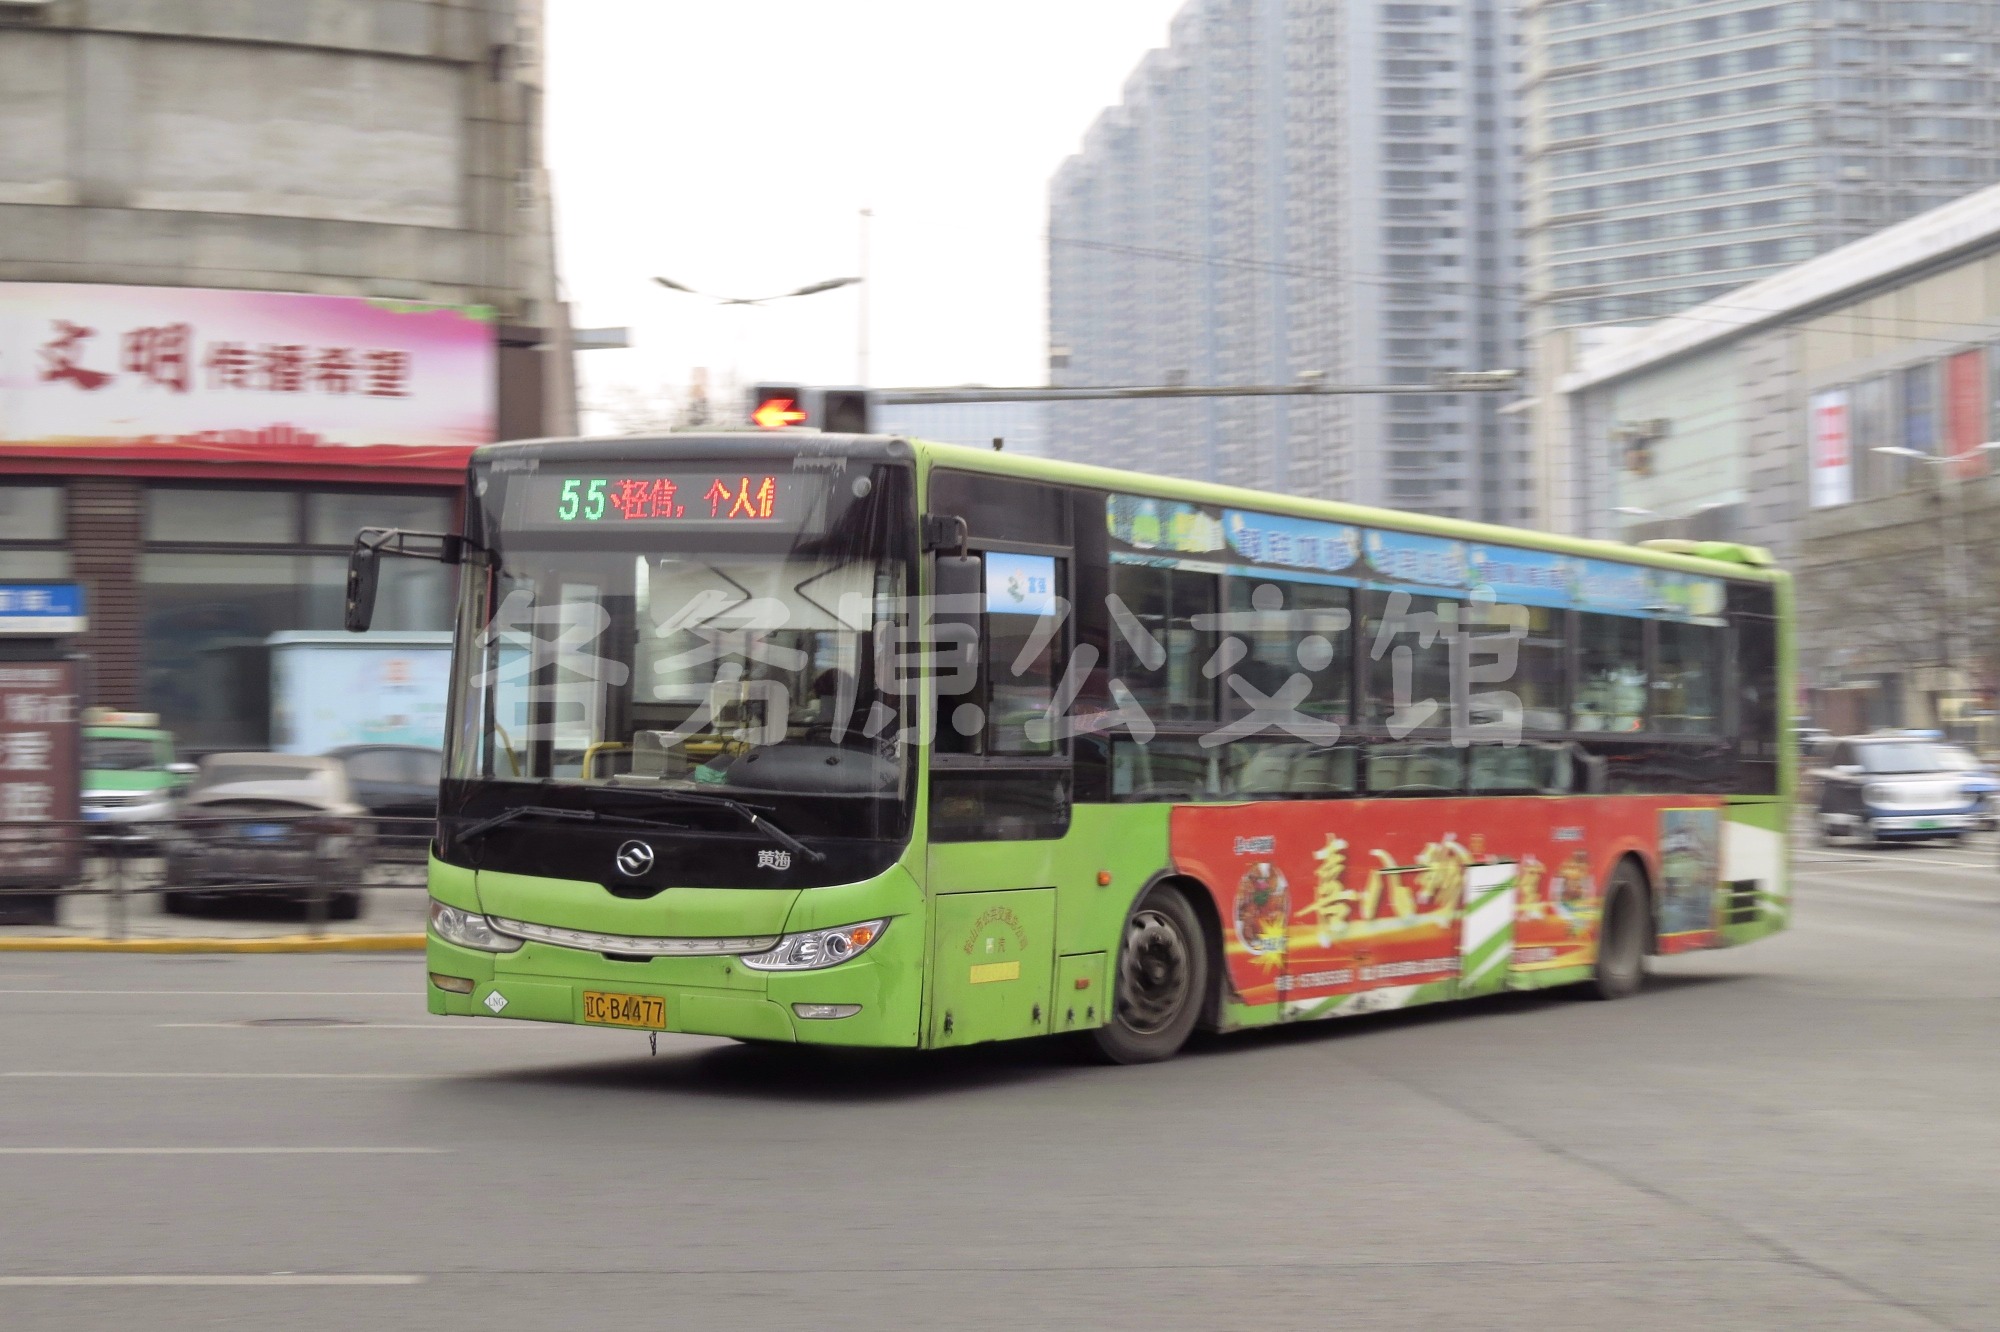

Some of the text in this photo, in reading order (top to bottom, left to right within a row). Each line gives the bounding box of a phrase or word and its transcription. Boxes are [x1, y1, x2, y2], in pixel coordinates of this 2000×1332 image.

[558, 478, 608, 521] 55
[757, 850, 791, 870] 黄海
[488, 997, 504, 1007] LNG
